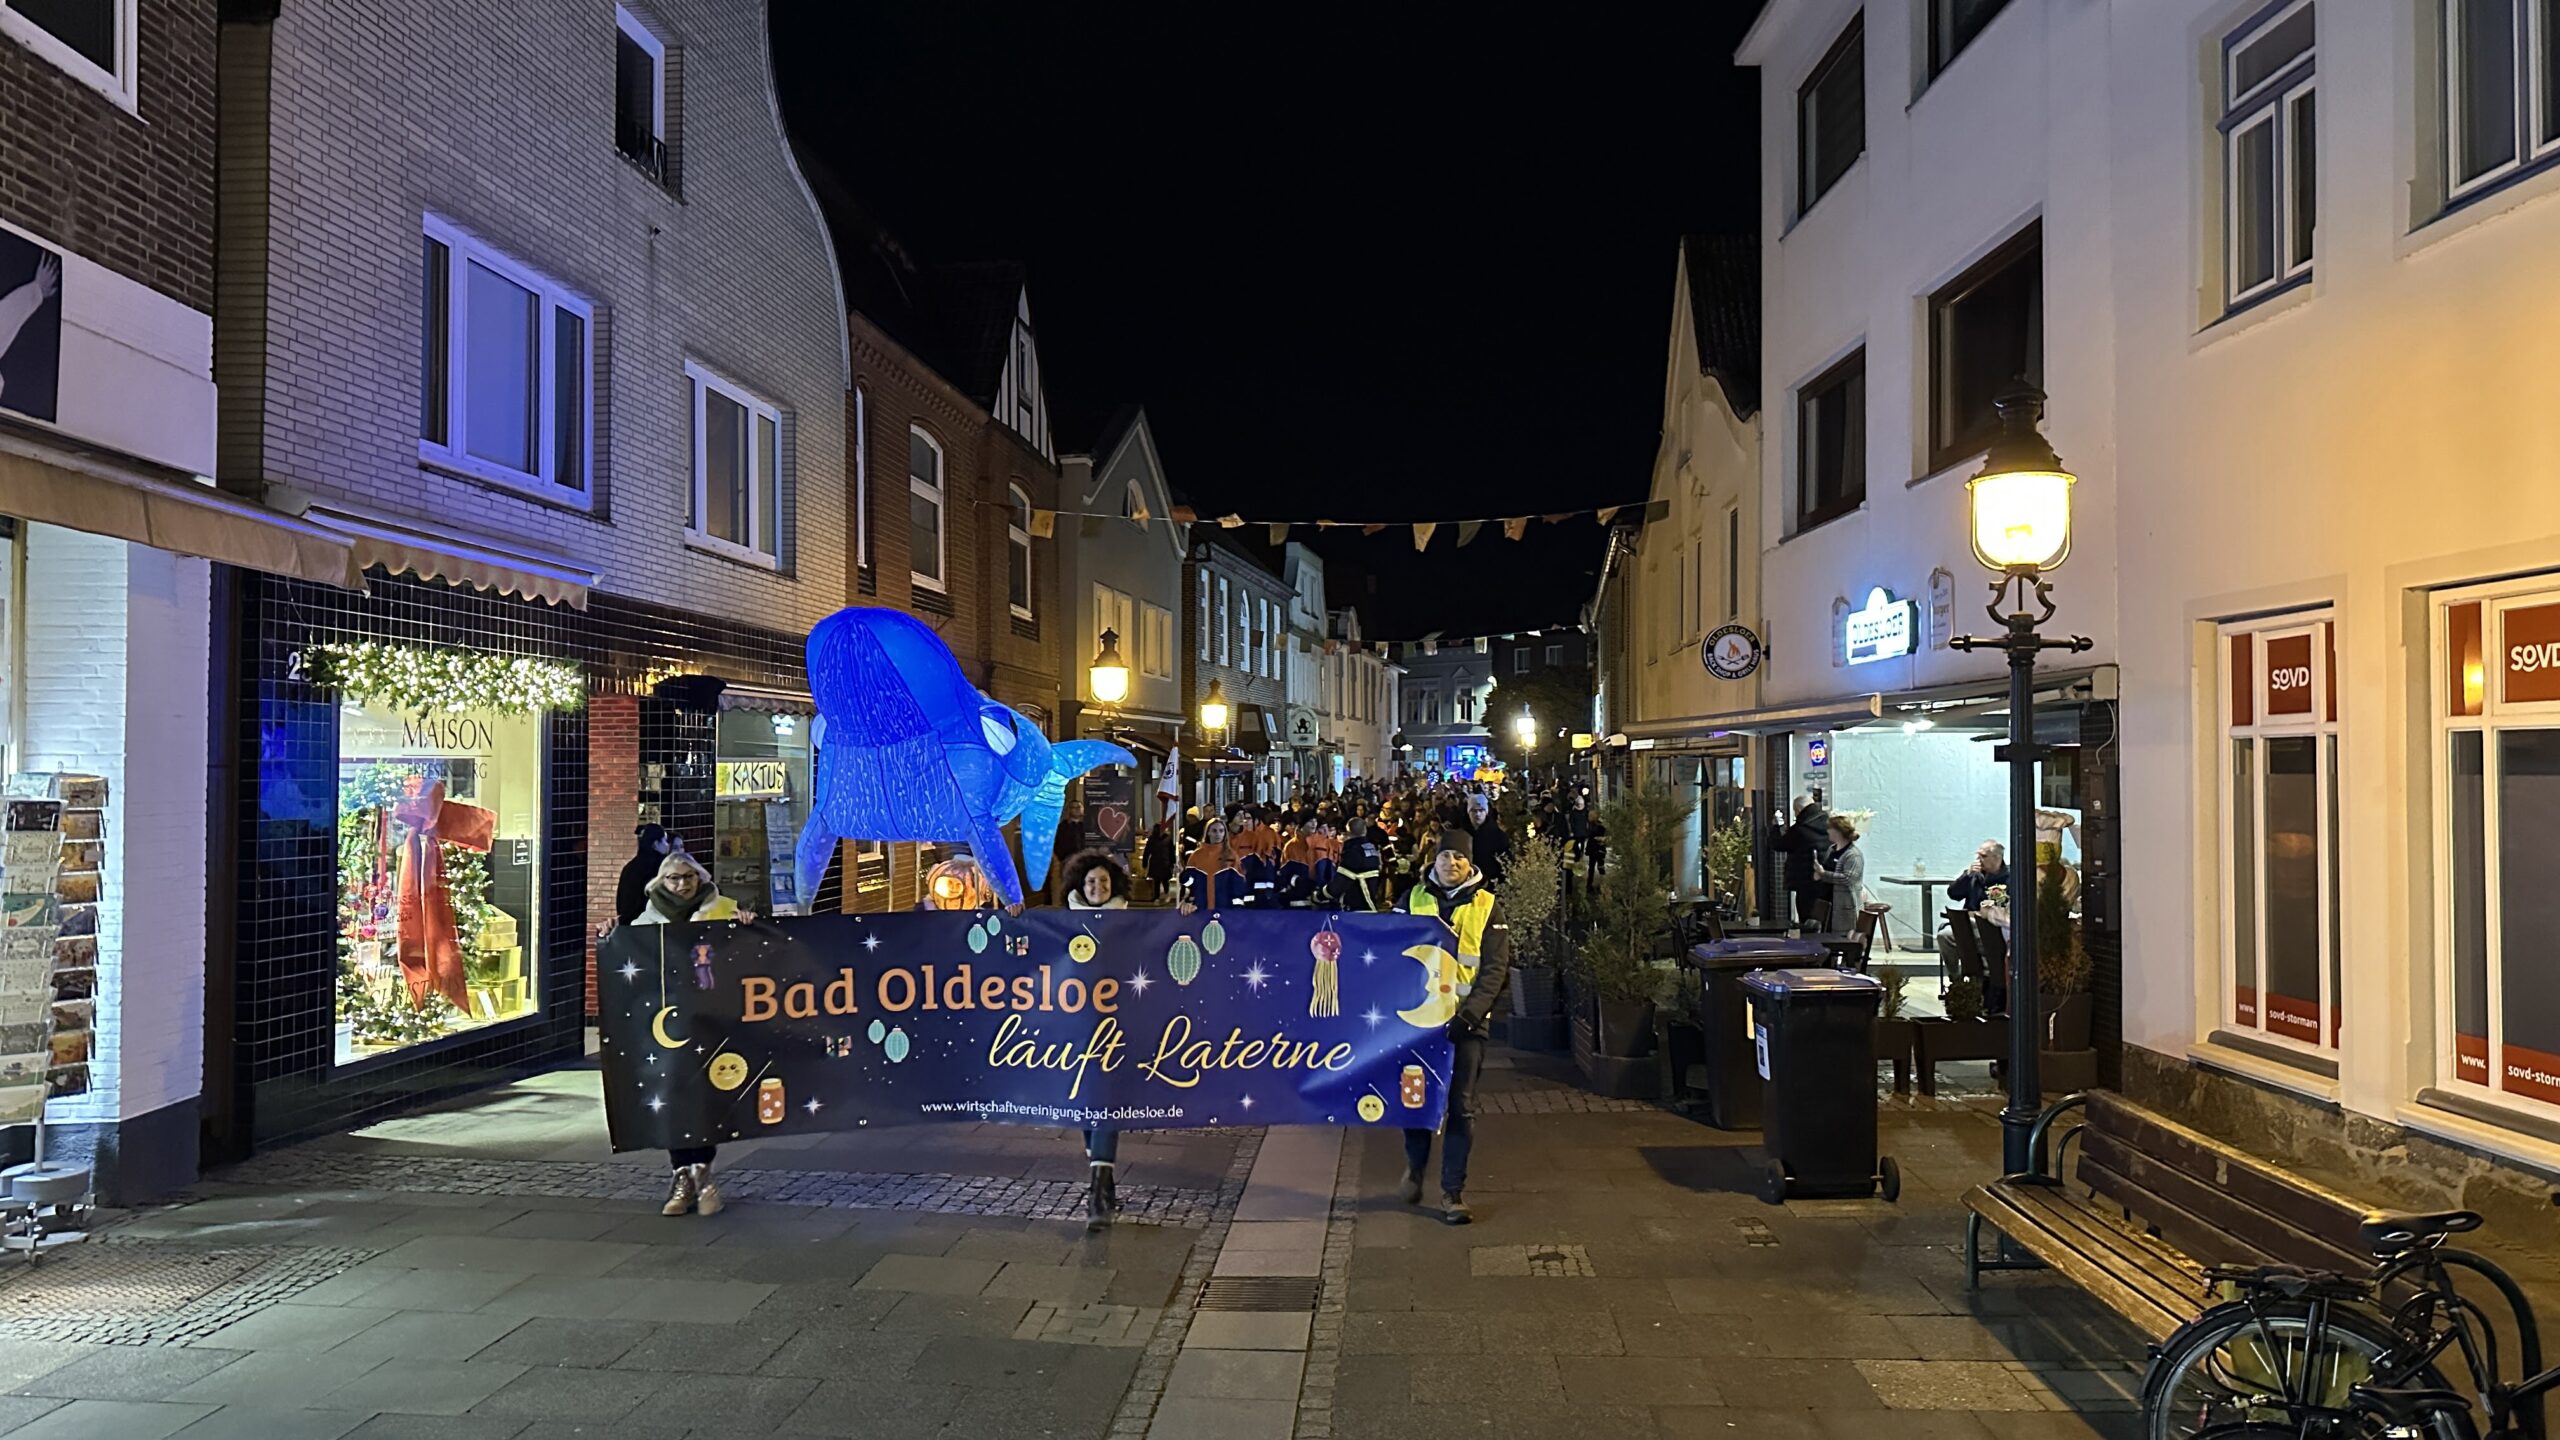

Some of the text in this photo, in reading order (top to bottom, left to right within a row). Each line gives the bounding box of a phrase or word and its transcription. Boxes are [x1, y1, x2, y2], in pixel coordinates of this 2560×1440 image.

[1709, 626, 1756, 646] OLDESLOER
[1715, 666, 1731, 677] SHOP
[402, 717, 493, 750] MAISON
[733, 761, 784, 794] KAKTUS
[741, 963, 1119, 1023] Bad Oldesloe
[2238, 1003, 2318, 1030] www. sovd-stormarn
[988, 1014, 1356, 1100] läuft Laterne
[2461, 1054, 2486, 1070] www.
[921, 1100, 1184, 1120] www.wirtschaftvereinigung-bad-oldesloe.de
